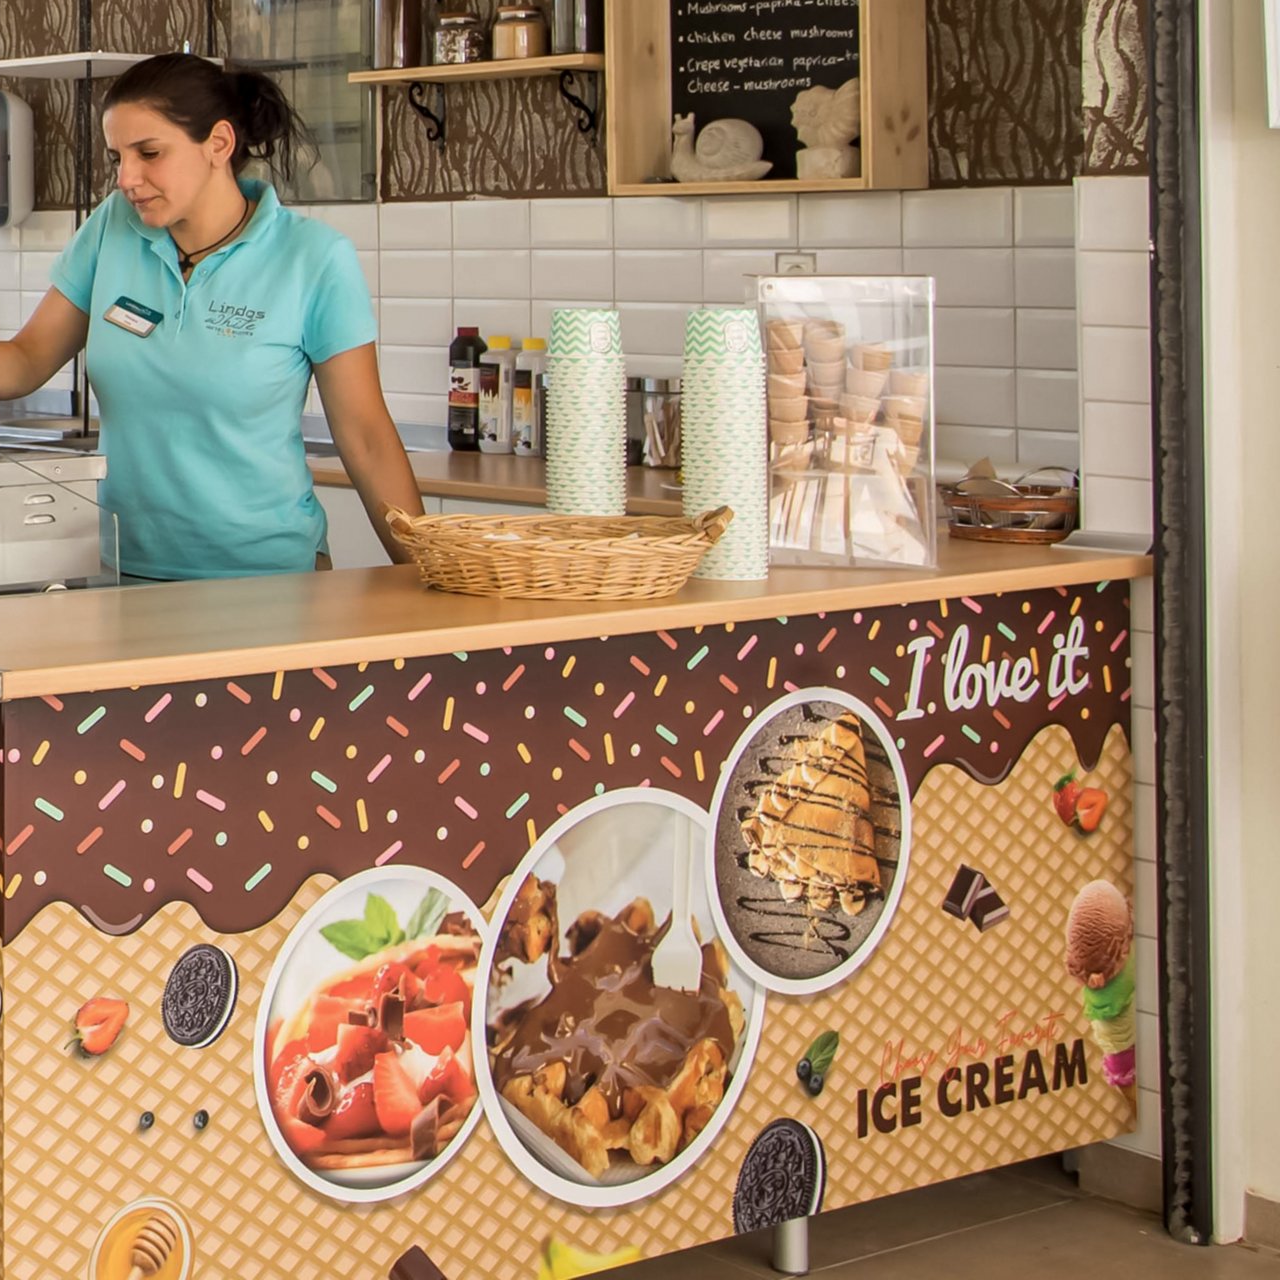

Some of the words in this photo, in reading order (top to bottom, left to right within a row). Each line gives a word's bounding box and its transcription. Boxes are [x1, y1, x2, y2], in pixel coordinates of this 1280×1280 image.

[790, 25, 854, 39] mushrooms
[686, 58, 720, 74] Crepe
[723, 56, 784, 73] vegetarian
[743, 76, 811, 91] mushrooms
[208, 299, 266, 320] Lindos
[896, 636, 935, 721] I
[944, 624, 1040, 712] love
[1047, 616, 1089, 698] it
[857, 1076, 922, 1139] ICE
[937, 1038, 1088, 1118] CREAM
